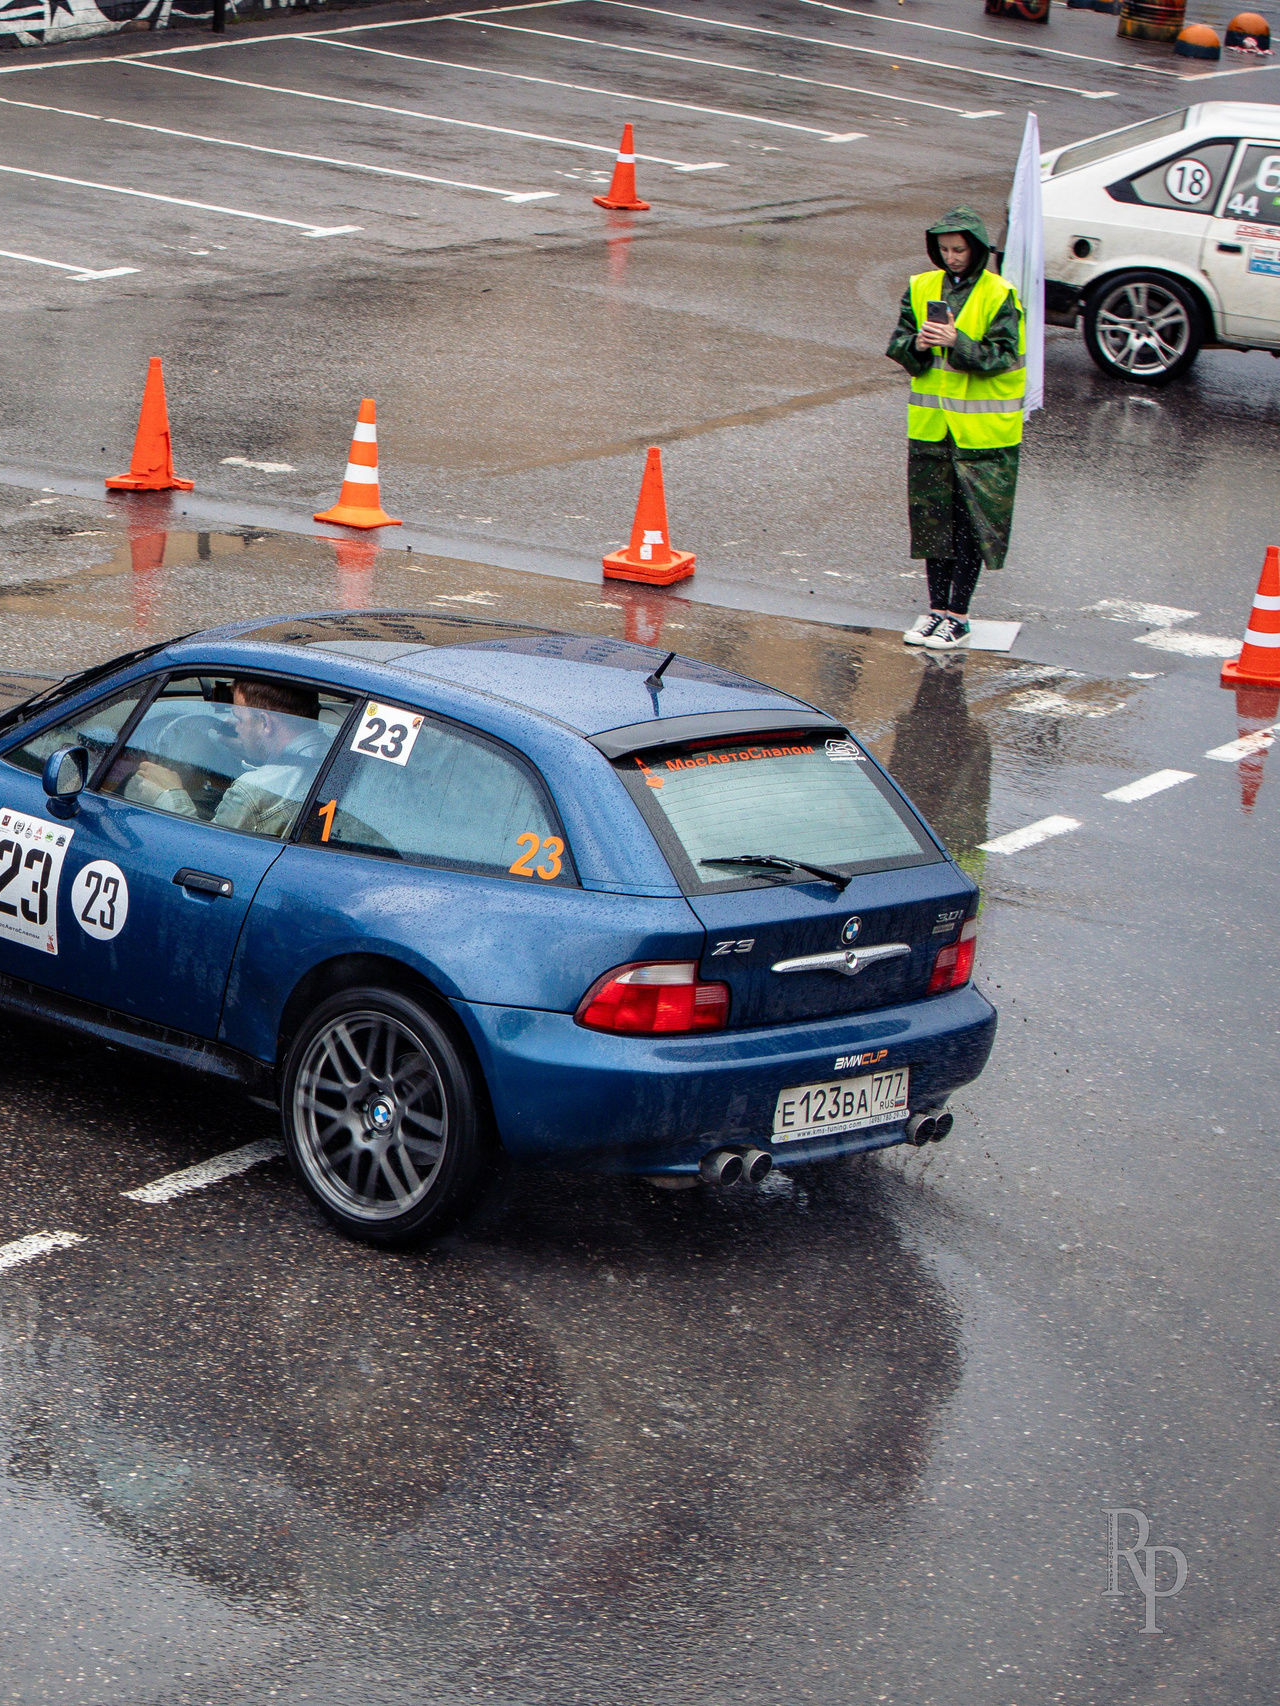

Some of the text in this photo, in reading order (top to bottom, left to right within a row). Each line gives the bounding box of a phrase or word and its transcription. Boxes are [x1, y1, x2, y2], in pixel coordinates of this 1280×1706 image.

[1176, 166, 1204, 195] 18
[1226, 193, 1260, 217] 44
[357, 717, 408, 758] 23
[665, 745, 815, 772] МосАвтоСлалом
[318, 800, 337, 842] 1
[508, 832, 565, 880] 23
[81, 870, 120, 930] 23
[711, 938, 755, 956] Z3
[873, 1072, 904, 1102] 777
[880, 1098, 895, 1111] RUS
[797, 1120, 862, 1138] www.kms-tuning.com
